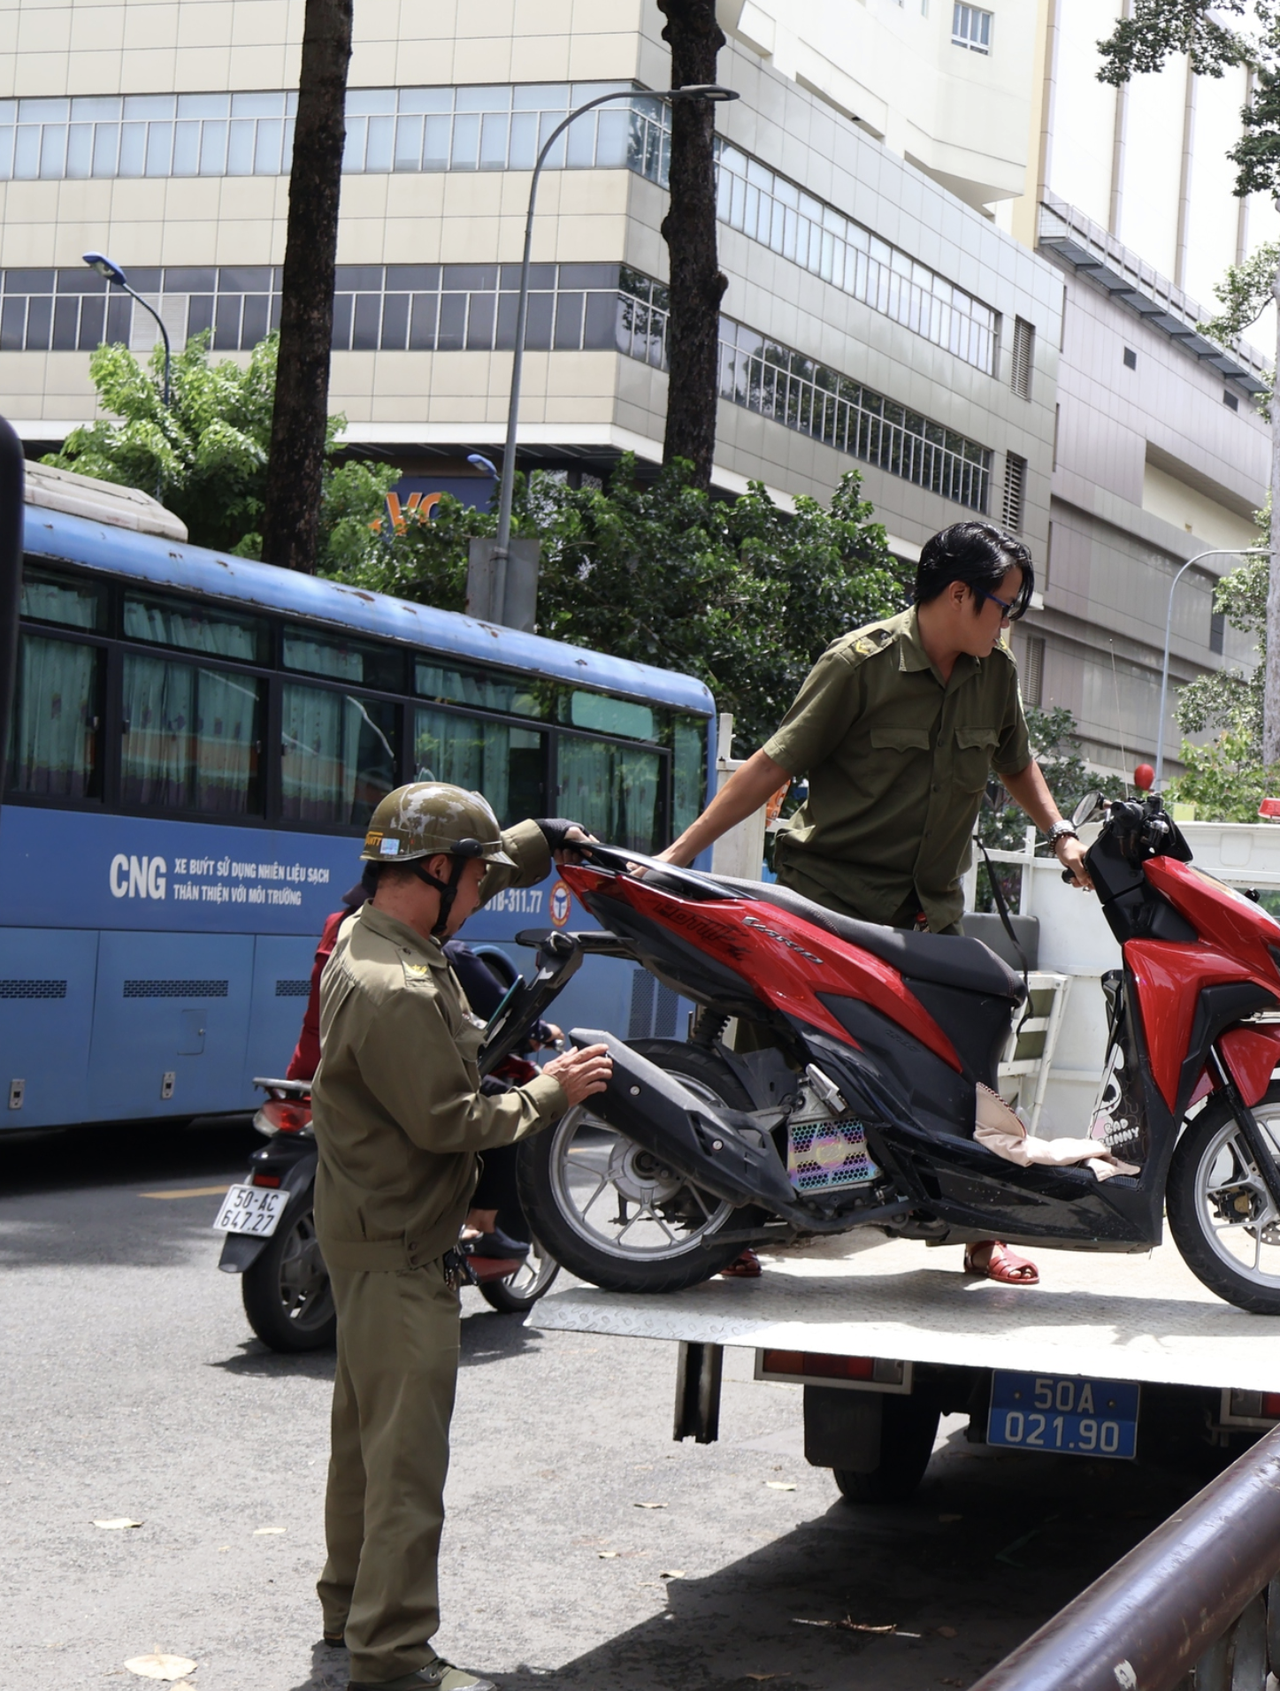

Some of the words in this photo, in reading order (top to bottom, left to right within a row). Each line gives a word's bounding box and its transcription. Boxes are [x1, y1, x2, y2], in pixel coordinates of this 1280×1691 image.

[110, 854, 167, 900] CNG
[174, 858, 187, 874] XE
[190, 856, 215, 876] BUÝT
[217, 856, 231, 877] SỬ
[231, 861, 257, 881] DỤNG
[258, 861, 285, 880] NHIÊN
[286, 863, 306, 884] LIỆU
[307, 867, 330, 885] SẠCH
[173, 881, 200, 900] THÂN
[201, 883, 230, 904] THIỆN
[231, 884, 247, 903] VỚI
[248, 885, 266, 904] MÔI
[267, 887, 302, 906] TRƯỜNG
[1104, 1118, 1129, 1135] BAD
[234, 1189, 279, 1212] 50-AC
[220, 1209, 275, 1232] 647.27
[1034, 1378, 1095, 1414] 50A
[1004, 1411, 1119, 1453] 021.90
